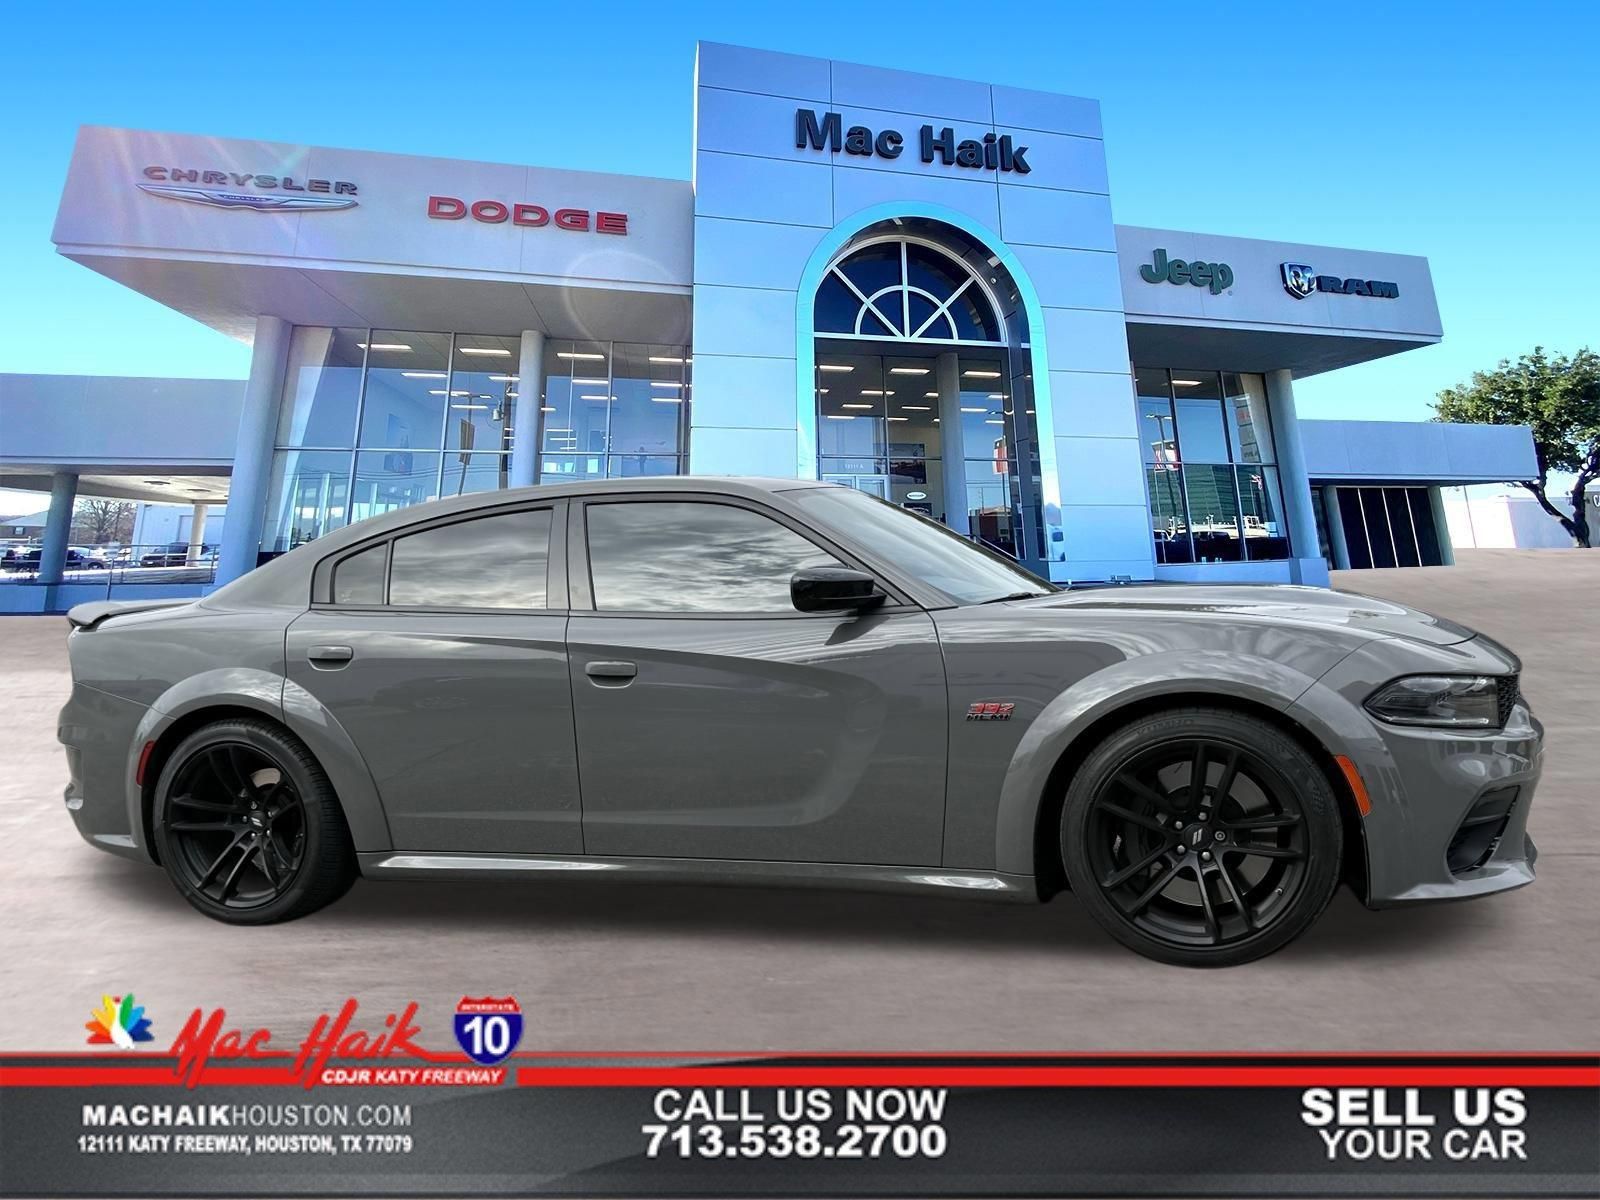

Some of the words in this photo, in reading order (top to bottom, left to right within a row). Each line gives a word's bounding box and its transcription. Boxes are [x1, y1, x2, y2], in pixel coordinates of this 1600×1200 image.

[796, 108, 904, 160] Mac
[920, 124, 1032, 174] Haik
[143, 165, 357, 196] CHRYSLER
[428, 195, 628, 236] DODGE
[1140, 248, 1234, 296] Jeep
[1315, 275, 1400, 299] RAM
[968, 702, 1015, 714] 392
